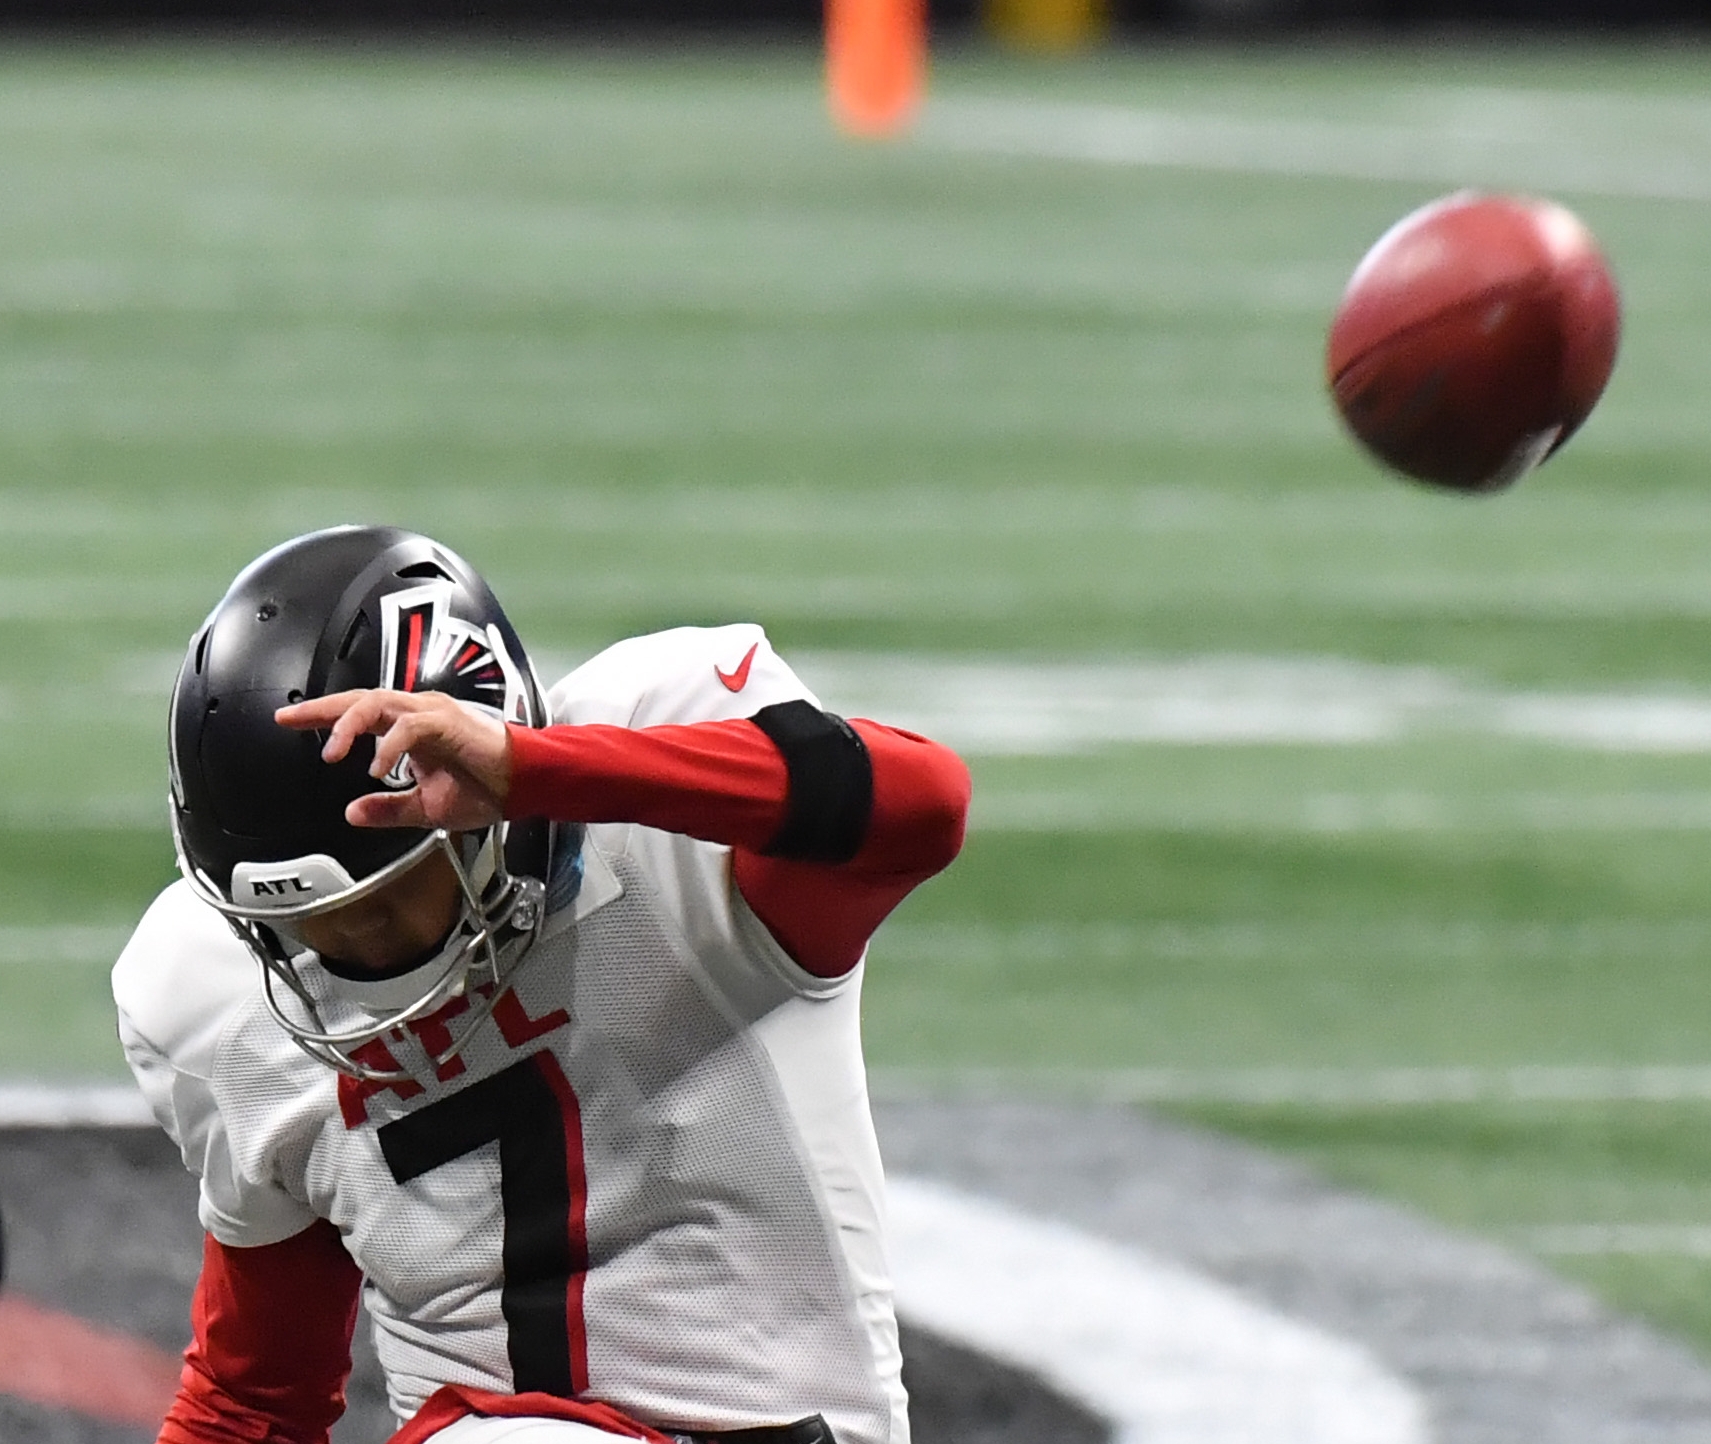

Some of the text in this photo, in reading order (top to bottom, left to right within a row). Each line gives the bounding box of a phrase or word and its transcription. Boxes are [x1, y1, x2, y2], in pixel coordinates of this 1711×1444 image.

[250, 877, 313, 897] ATL
[337, 980, 571, 1130] ATL
[376, 1048, 588, 1397] 7
